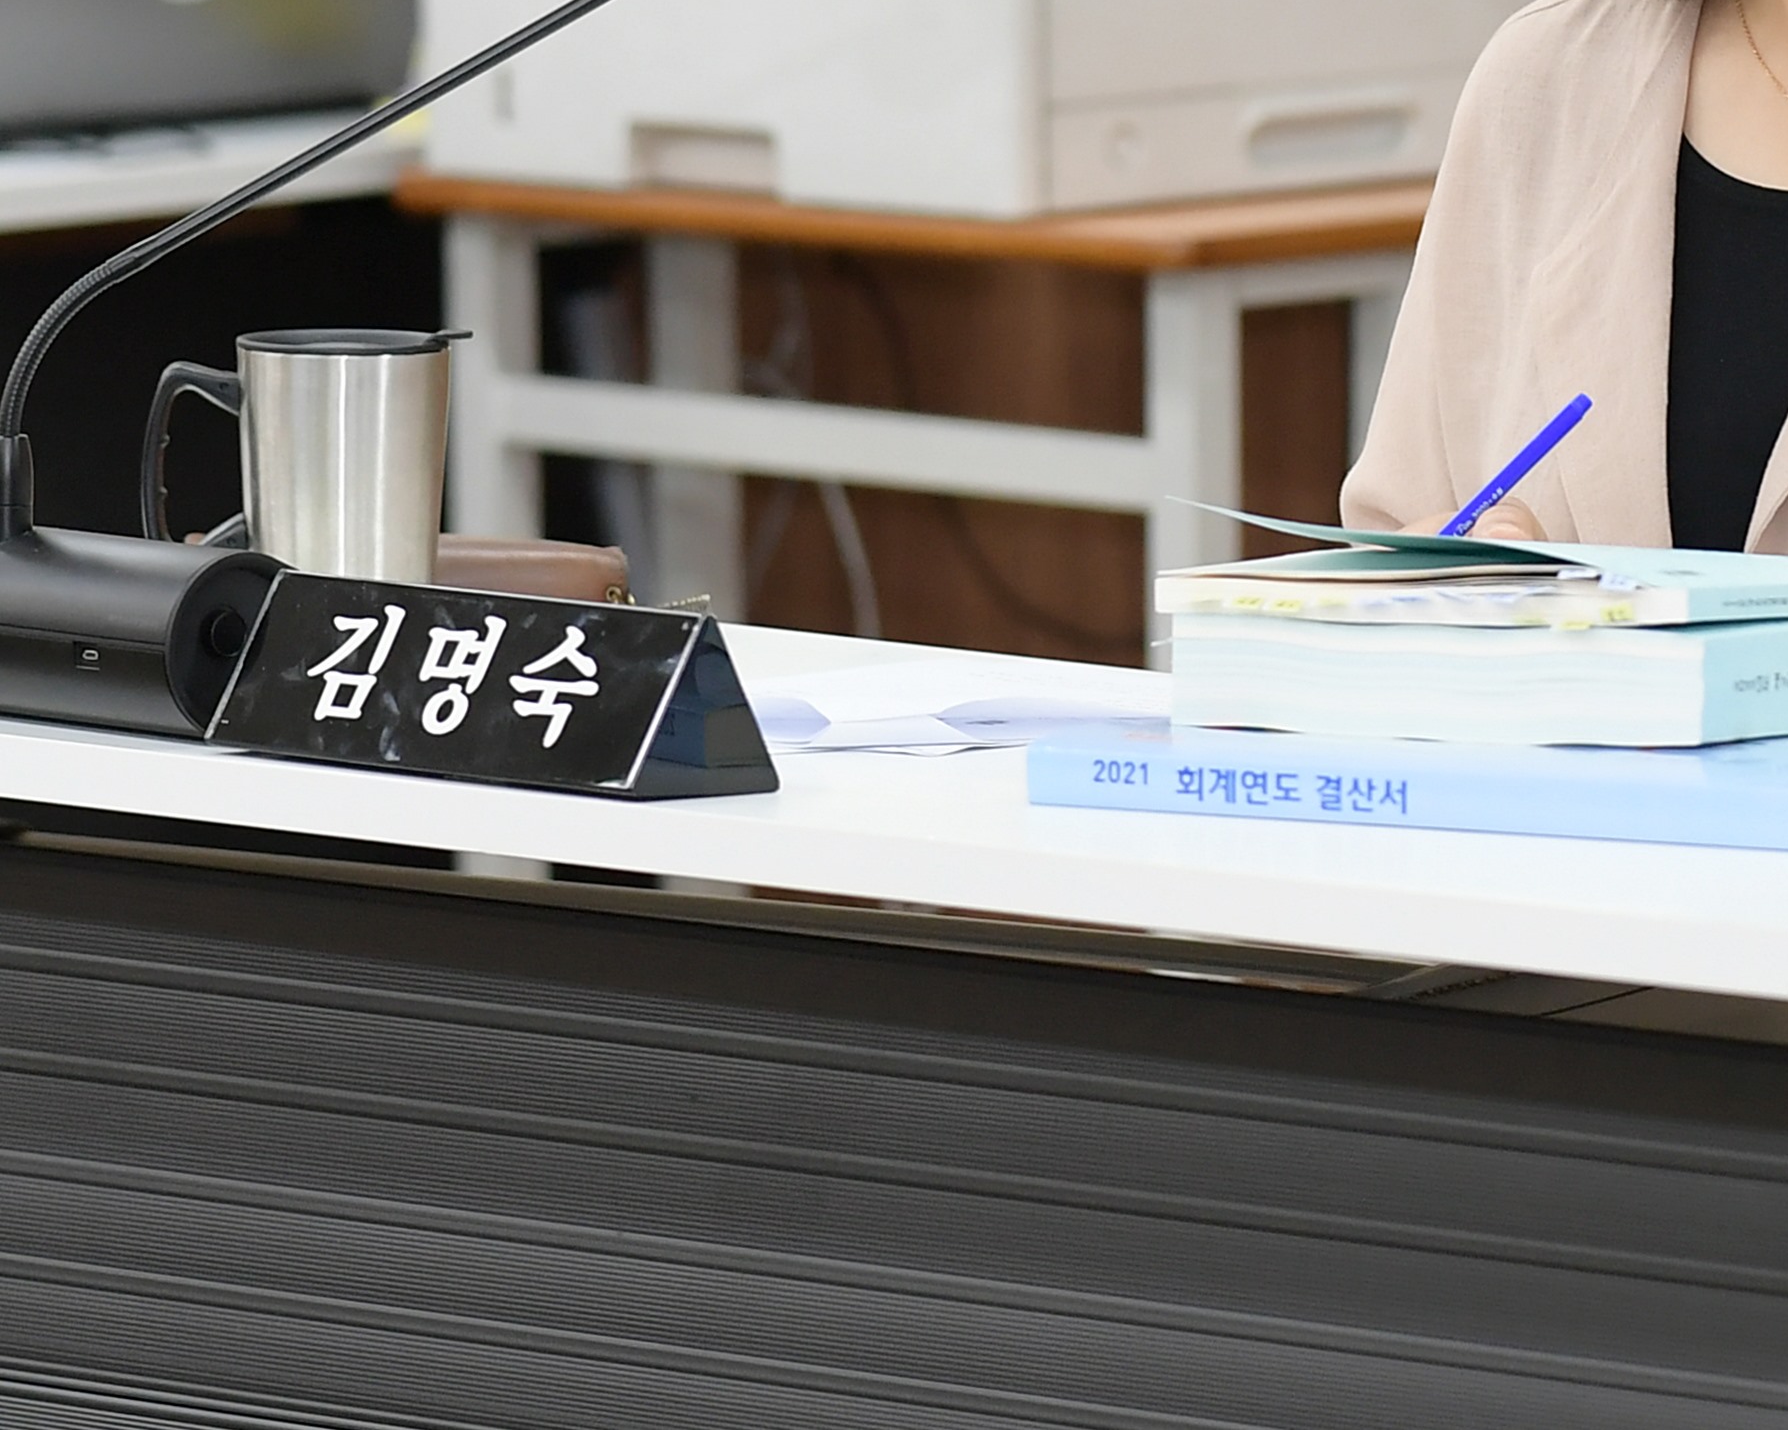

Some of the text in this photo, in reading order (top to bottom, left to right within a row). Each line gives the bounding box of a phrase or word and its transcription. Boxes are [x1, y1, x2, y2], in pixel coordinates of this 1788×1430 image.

[307, 604, 600, 749] 김명숙
[1093, 759, 1408, 815] 2021 회계연도 결산서
